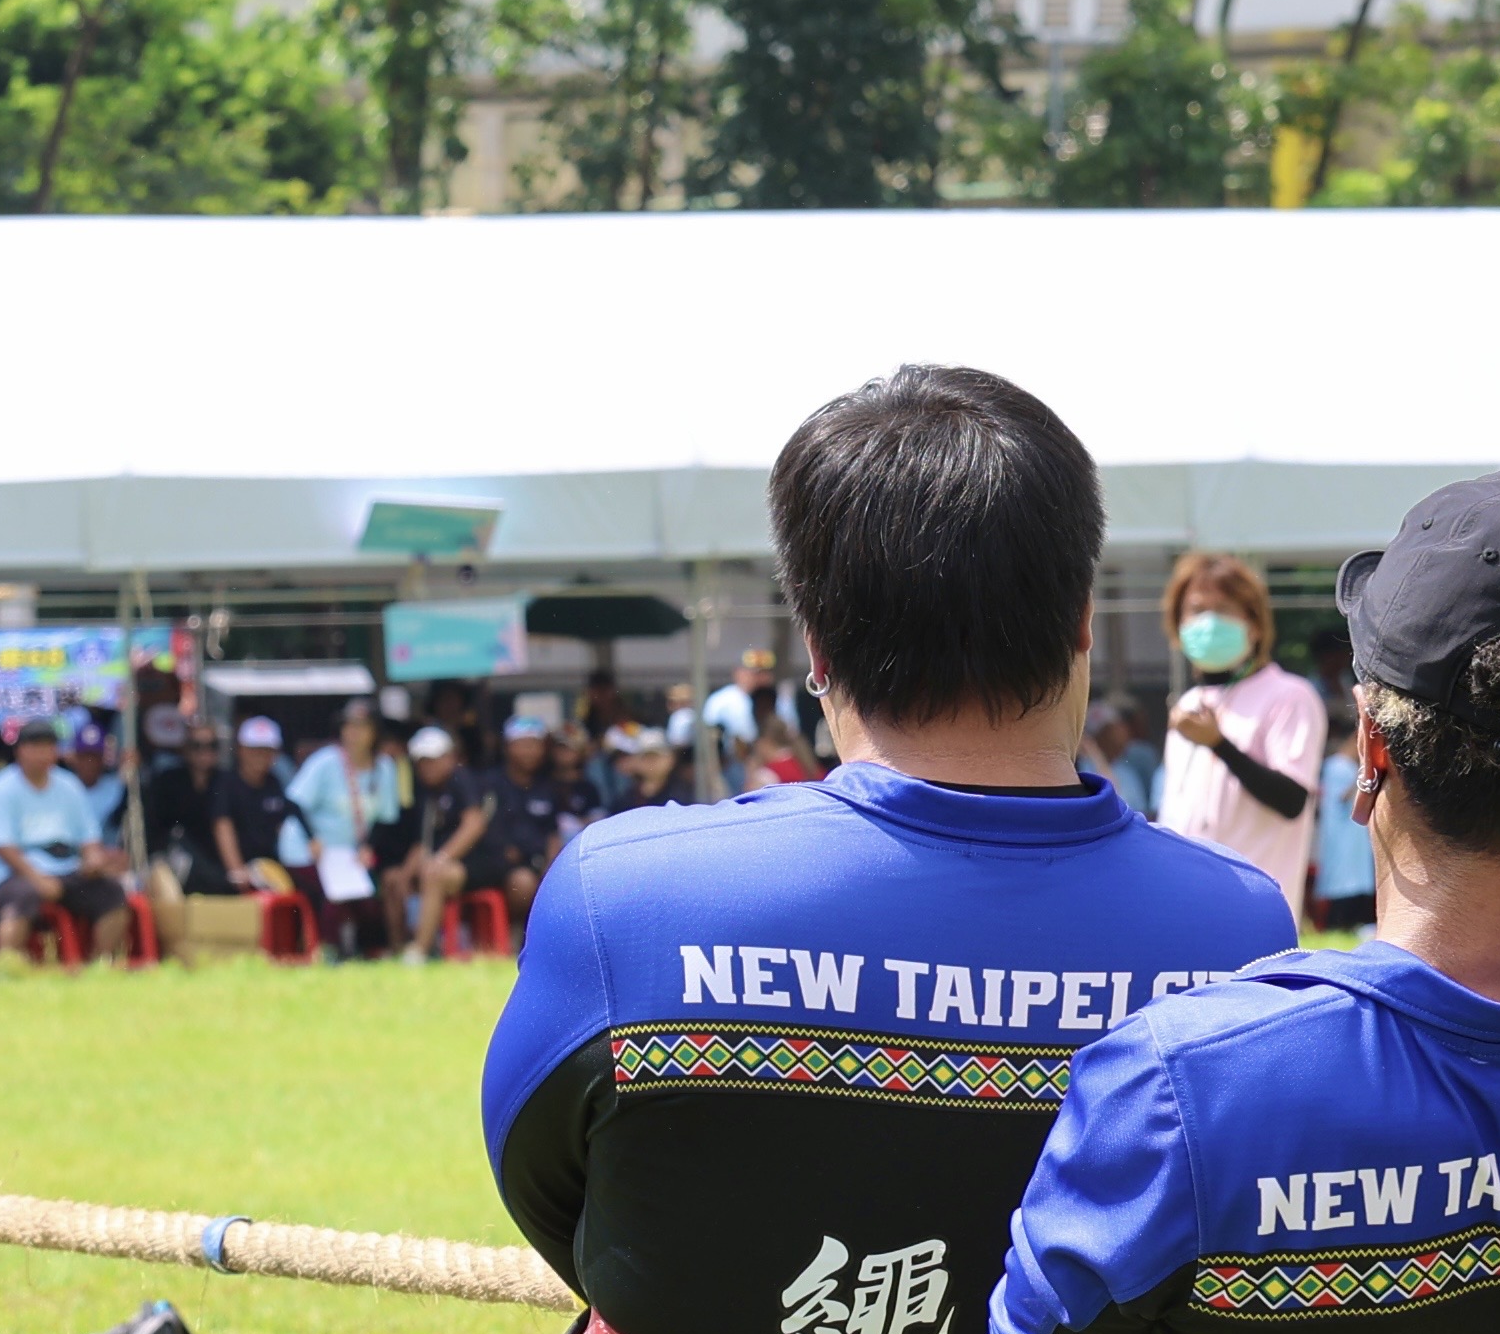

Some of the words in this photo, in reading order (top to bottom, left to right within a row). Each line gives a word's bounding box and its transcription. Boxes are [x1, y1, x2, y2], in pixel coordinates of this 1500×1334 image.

[680, 945, 865, 1014] NEW
[883, 957, 1139, 1030] TAIPEI
[1257, 1165, 1422, 1236] NEW
